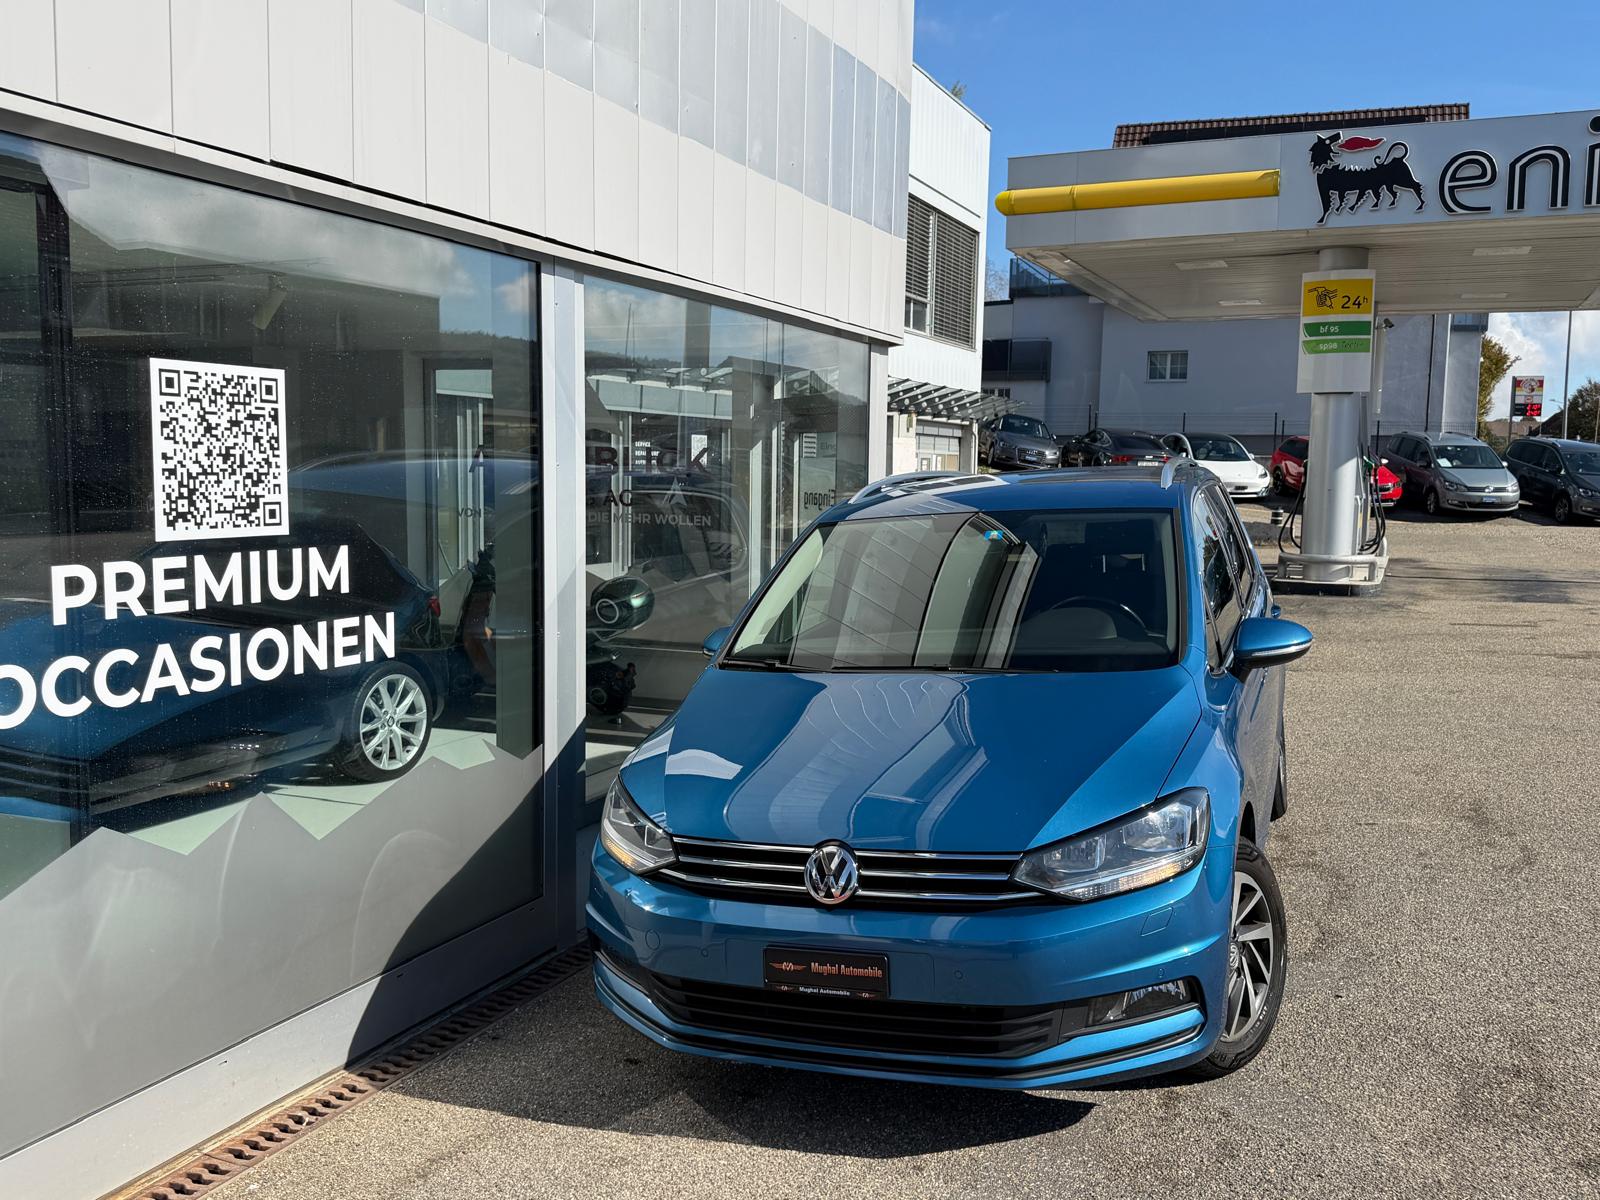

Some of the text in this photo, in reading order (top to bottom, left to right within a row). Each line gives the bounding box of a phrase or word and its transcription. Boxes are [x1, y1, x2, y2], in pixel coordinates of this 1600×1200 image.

[1439, 115, 1600, 215] eni
[1330, 325, 1339, 333] 95
[1319, 342, 1338, 351] sp98
[613, 513, 650, 524] MEHR
[656, 514, 711, 527] WOLLEN
[51, 544, 350, 626] PREMIUM
[0, 611, 396, 731] OCCASIONEN
[811, 961, 883, 978] Mughal Automobile
